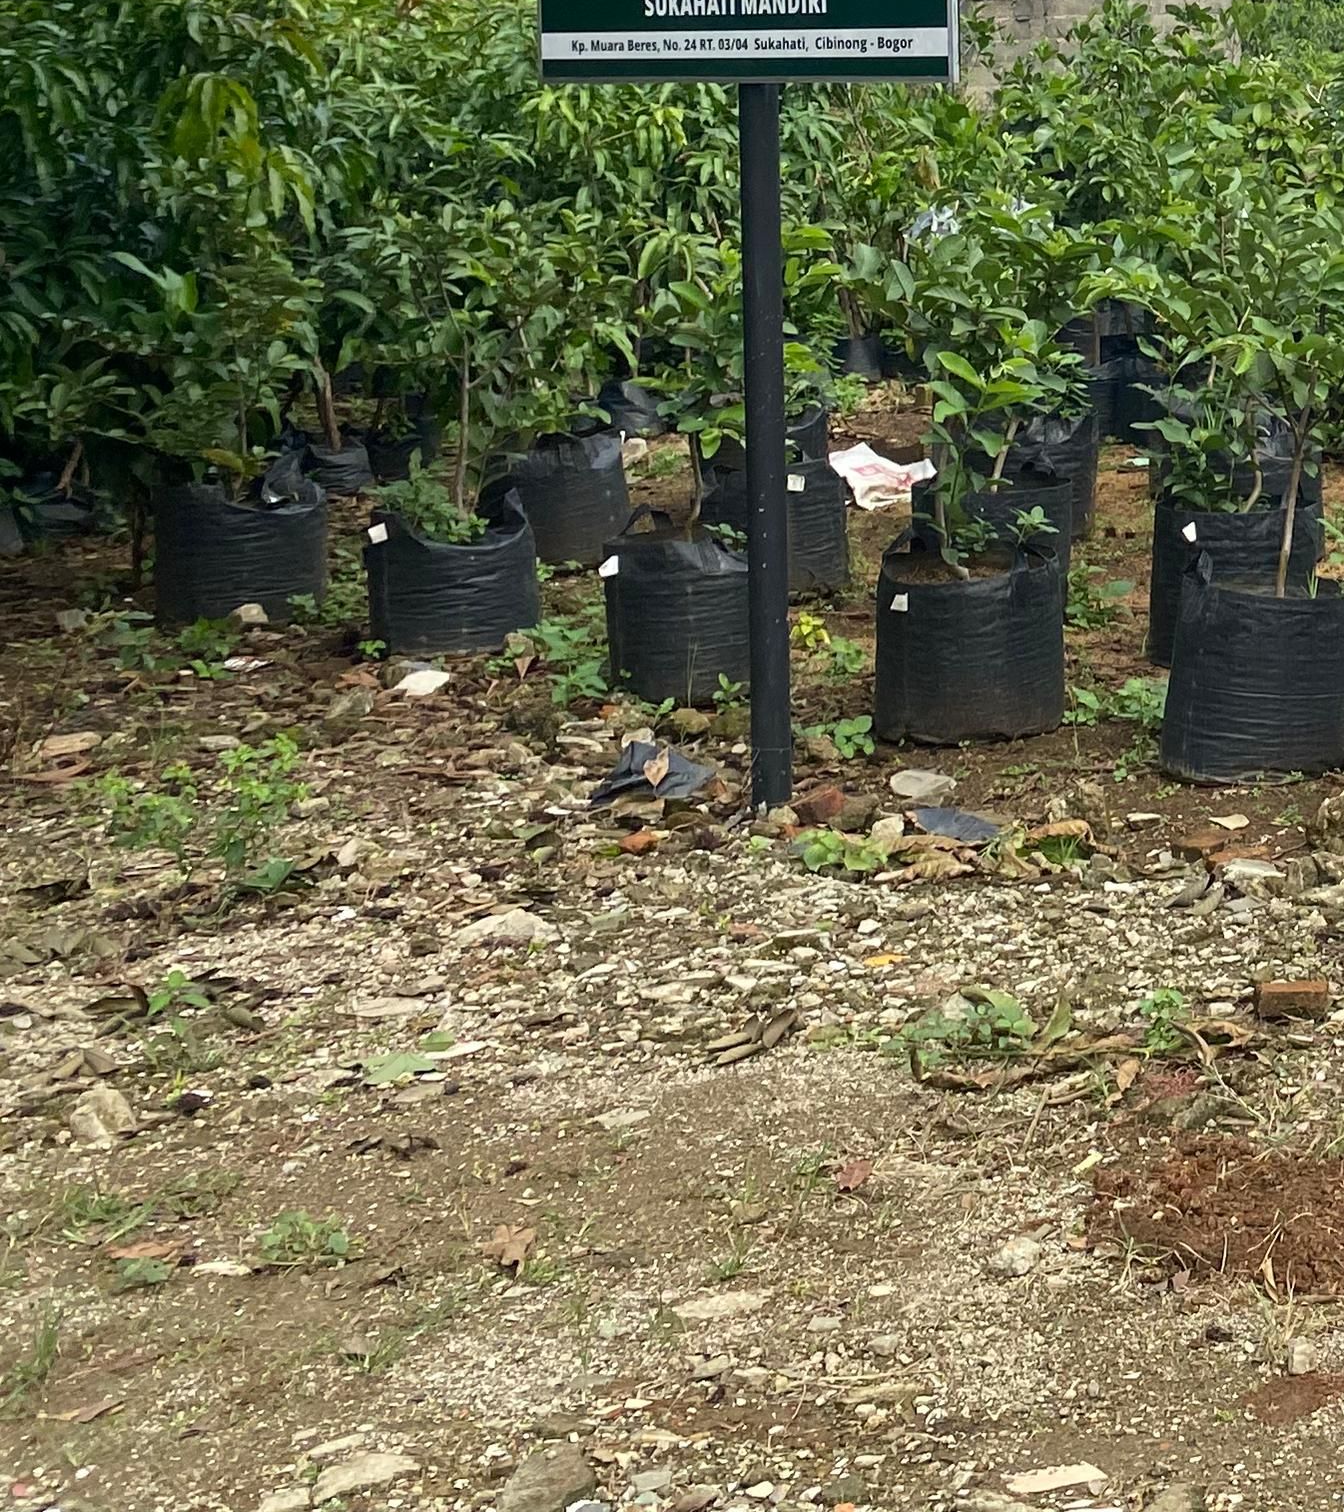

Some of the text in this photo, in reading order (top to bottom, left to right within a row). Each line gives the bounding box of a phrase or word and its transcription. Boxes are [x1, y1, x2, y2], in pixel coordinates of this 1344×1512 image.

[572, 40, 588, 55] Kp.
[591, 40, 624, 51] Muara
[628, 39, 660, 52] Beres,
[663, 39, 681, 51] No.
[684, 39, 697, 51] 24
[700, 39, 715, 50] RT.
[718, 38, 748, 51] 03/04
[754, 37, 809, 52] Sukahati,
[815, 36, 867, 53] Cibinong
[877, 37, 913, 52] Bogor
